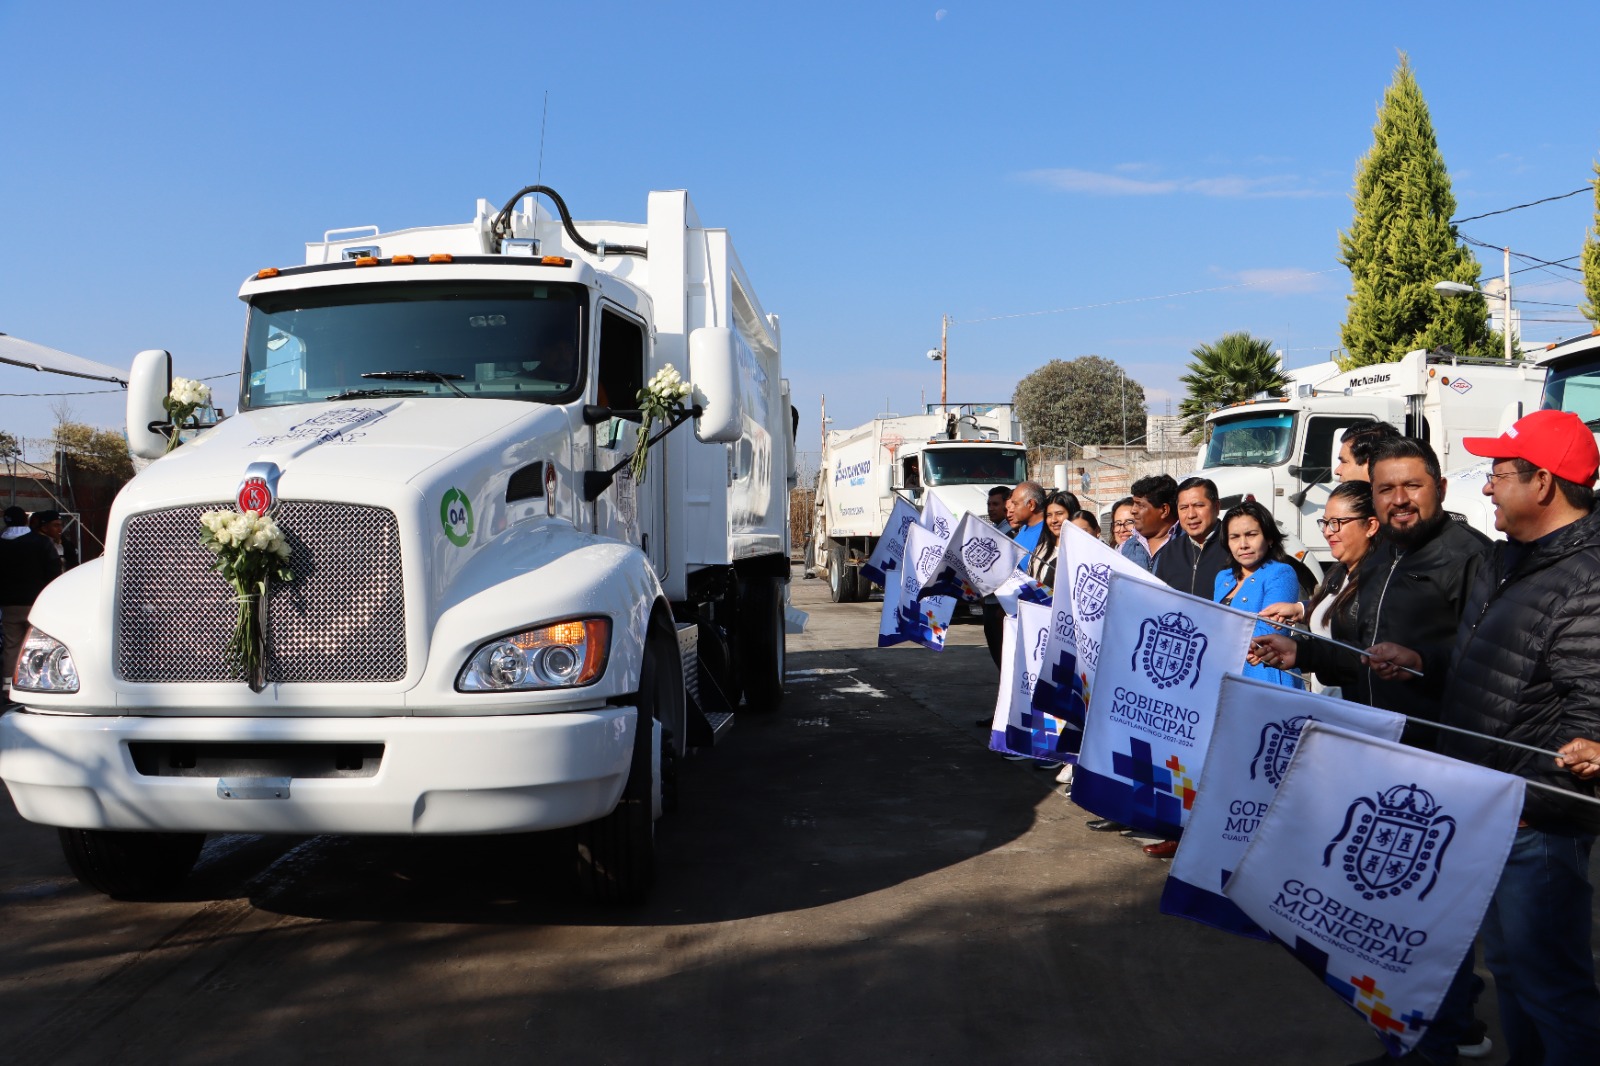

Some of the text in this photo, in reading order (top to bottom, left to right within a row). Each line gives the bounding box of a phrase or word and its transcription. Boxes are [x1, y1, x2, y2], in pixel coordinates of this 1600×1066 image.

[1350, 374, 1391, 387] McNeilus
[450, 508, 465, 525] 04
[1110, 700, 1196, 740] MUNICIPAL
[1114, 686, 1200, 724] GOBIERNO
[1109, 715, 1194, 748] CUAUTLANCINGO 2021-2024
[1272, 892, 1413, 965] MUNICIPAL
[1283, 879, 1428, 947] GOBIERNO
[1268, 904, 1408, 974] CUAUTLANCINGO 2021-2024
